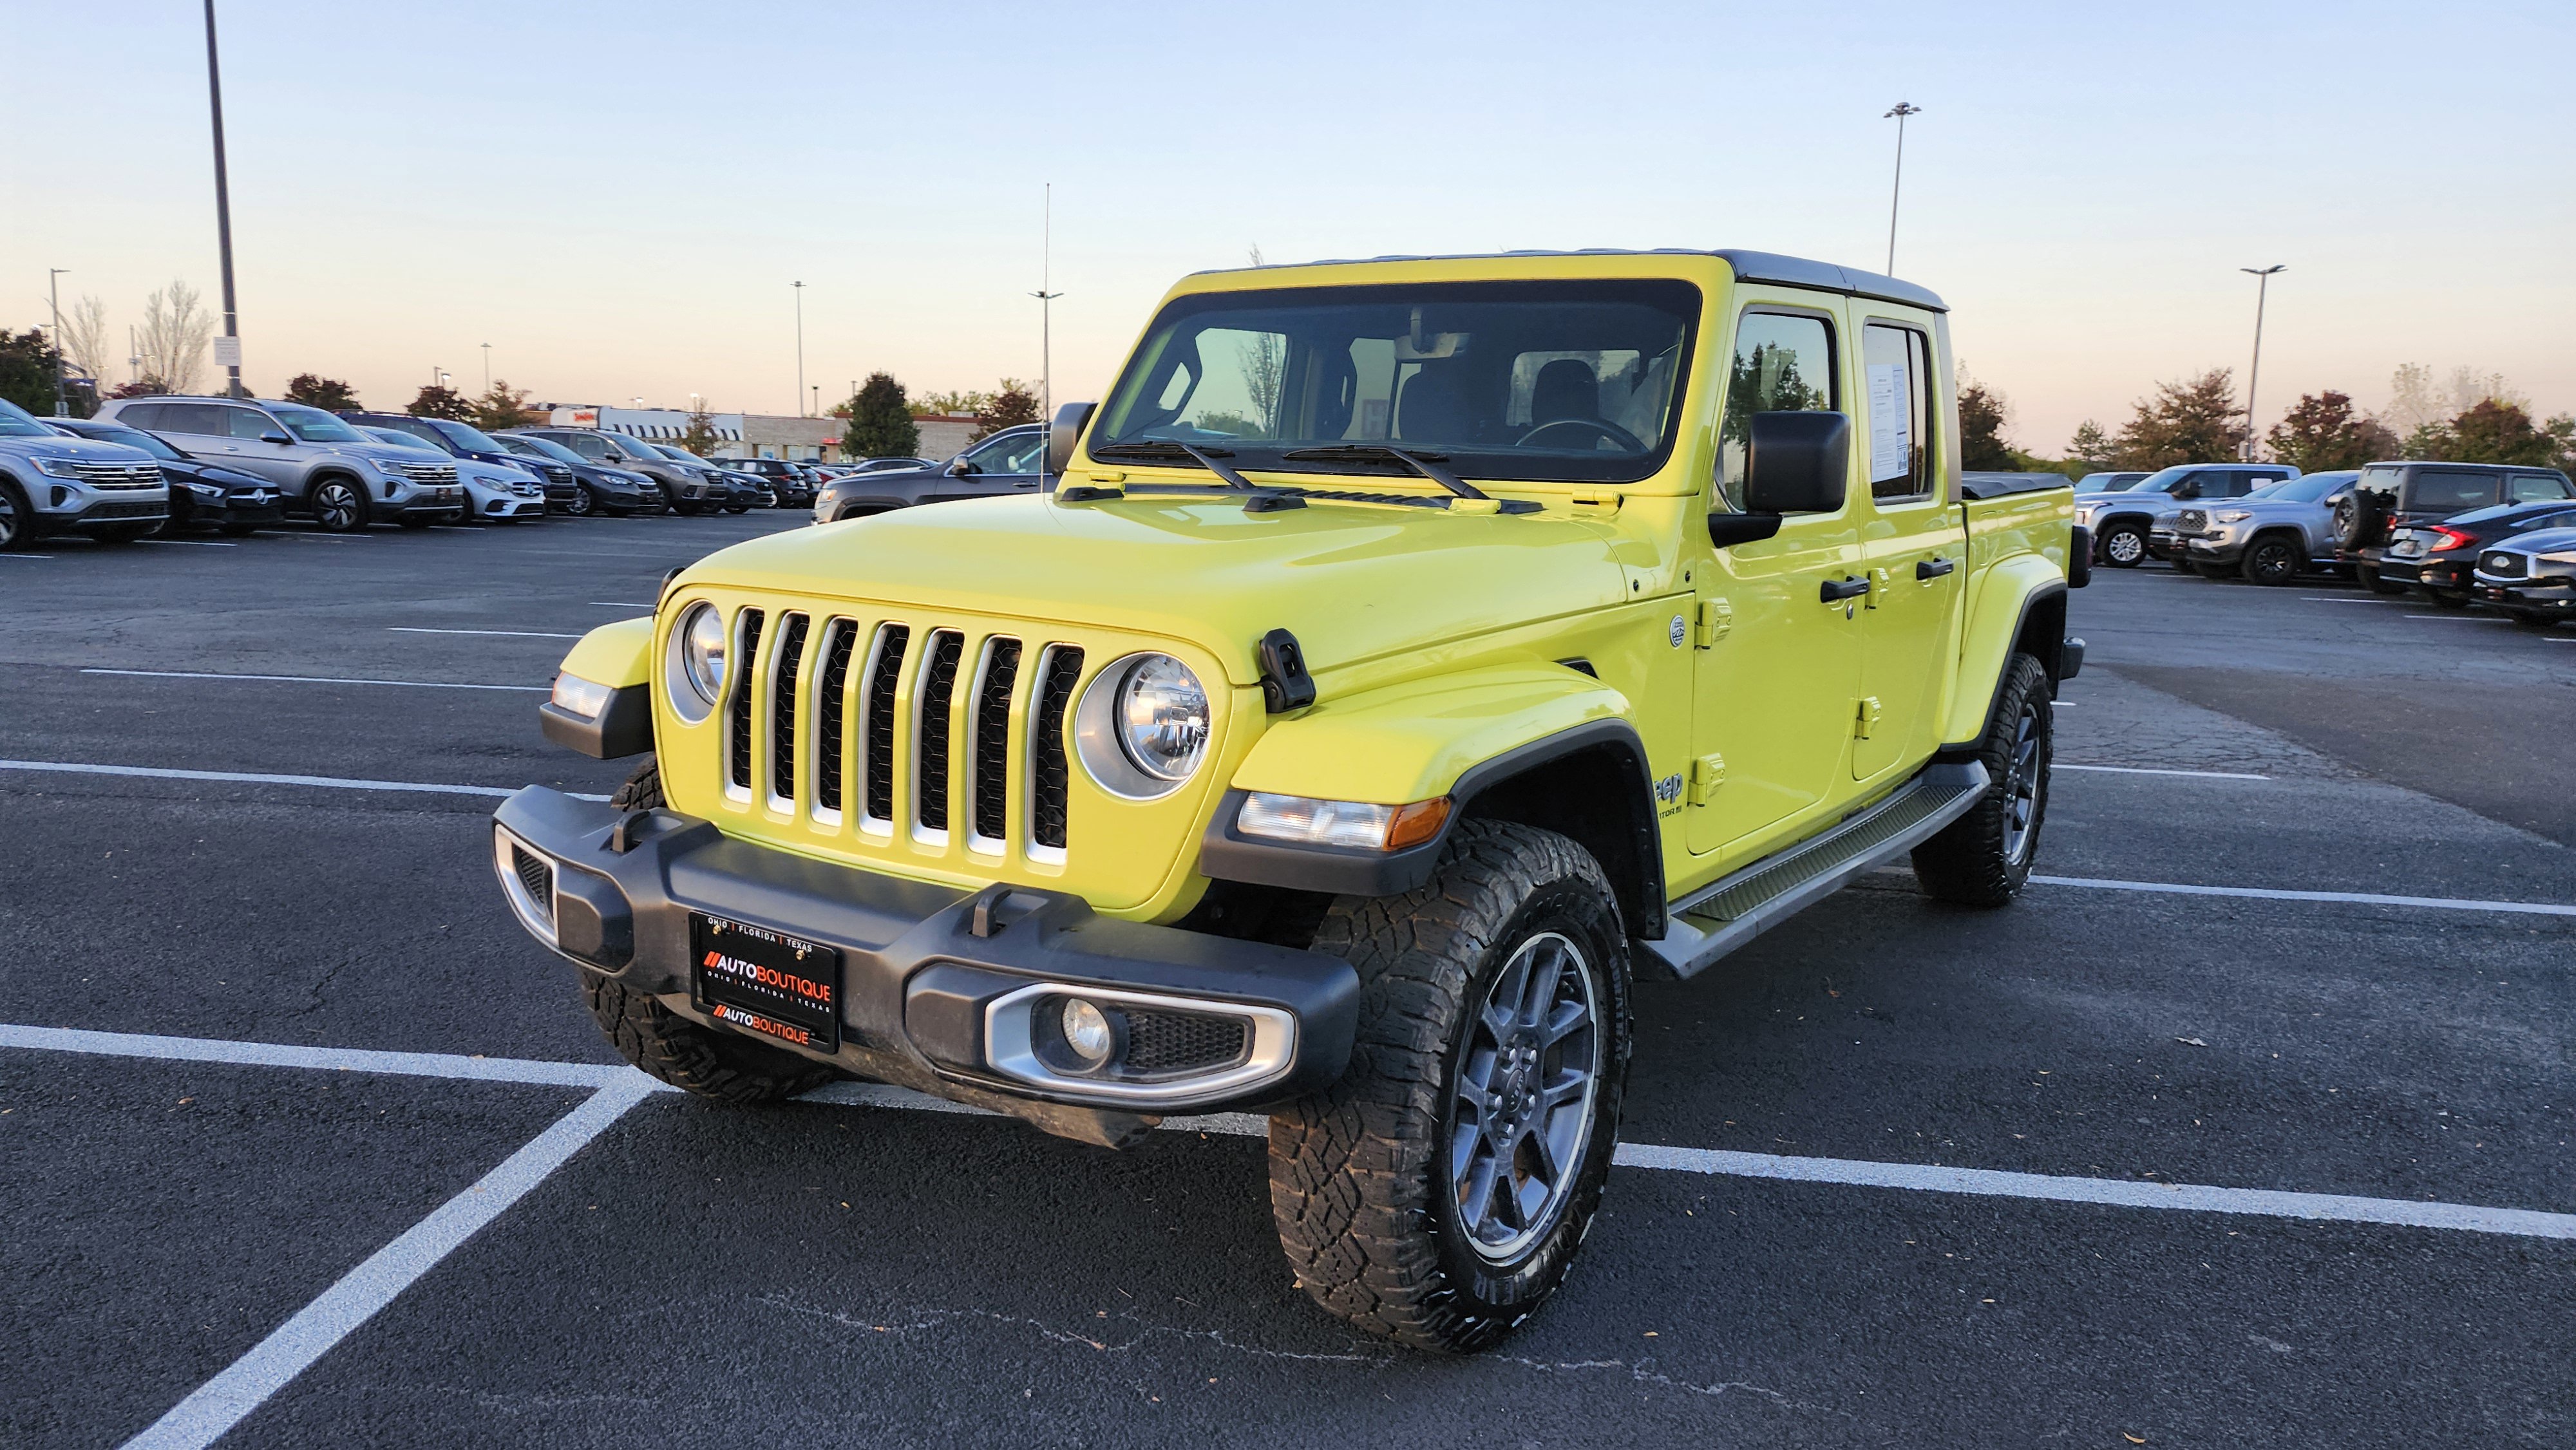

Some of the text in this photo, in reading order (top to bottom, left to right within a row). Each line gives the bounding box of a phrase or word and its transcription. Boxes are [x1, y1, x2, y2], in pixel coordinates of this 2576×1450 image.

[1654, 773, 1683, 804] eep
[708, 917, 812, 952] OHIO FLORIDA TEXAS
[708, 970, 830, 1013] OHIO FLORIDA TEXAS
